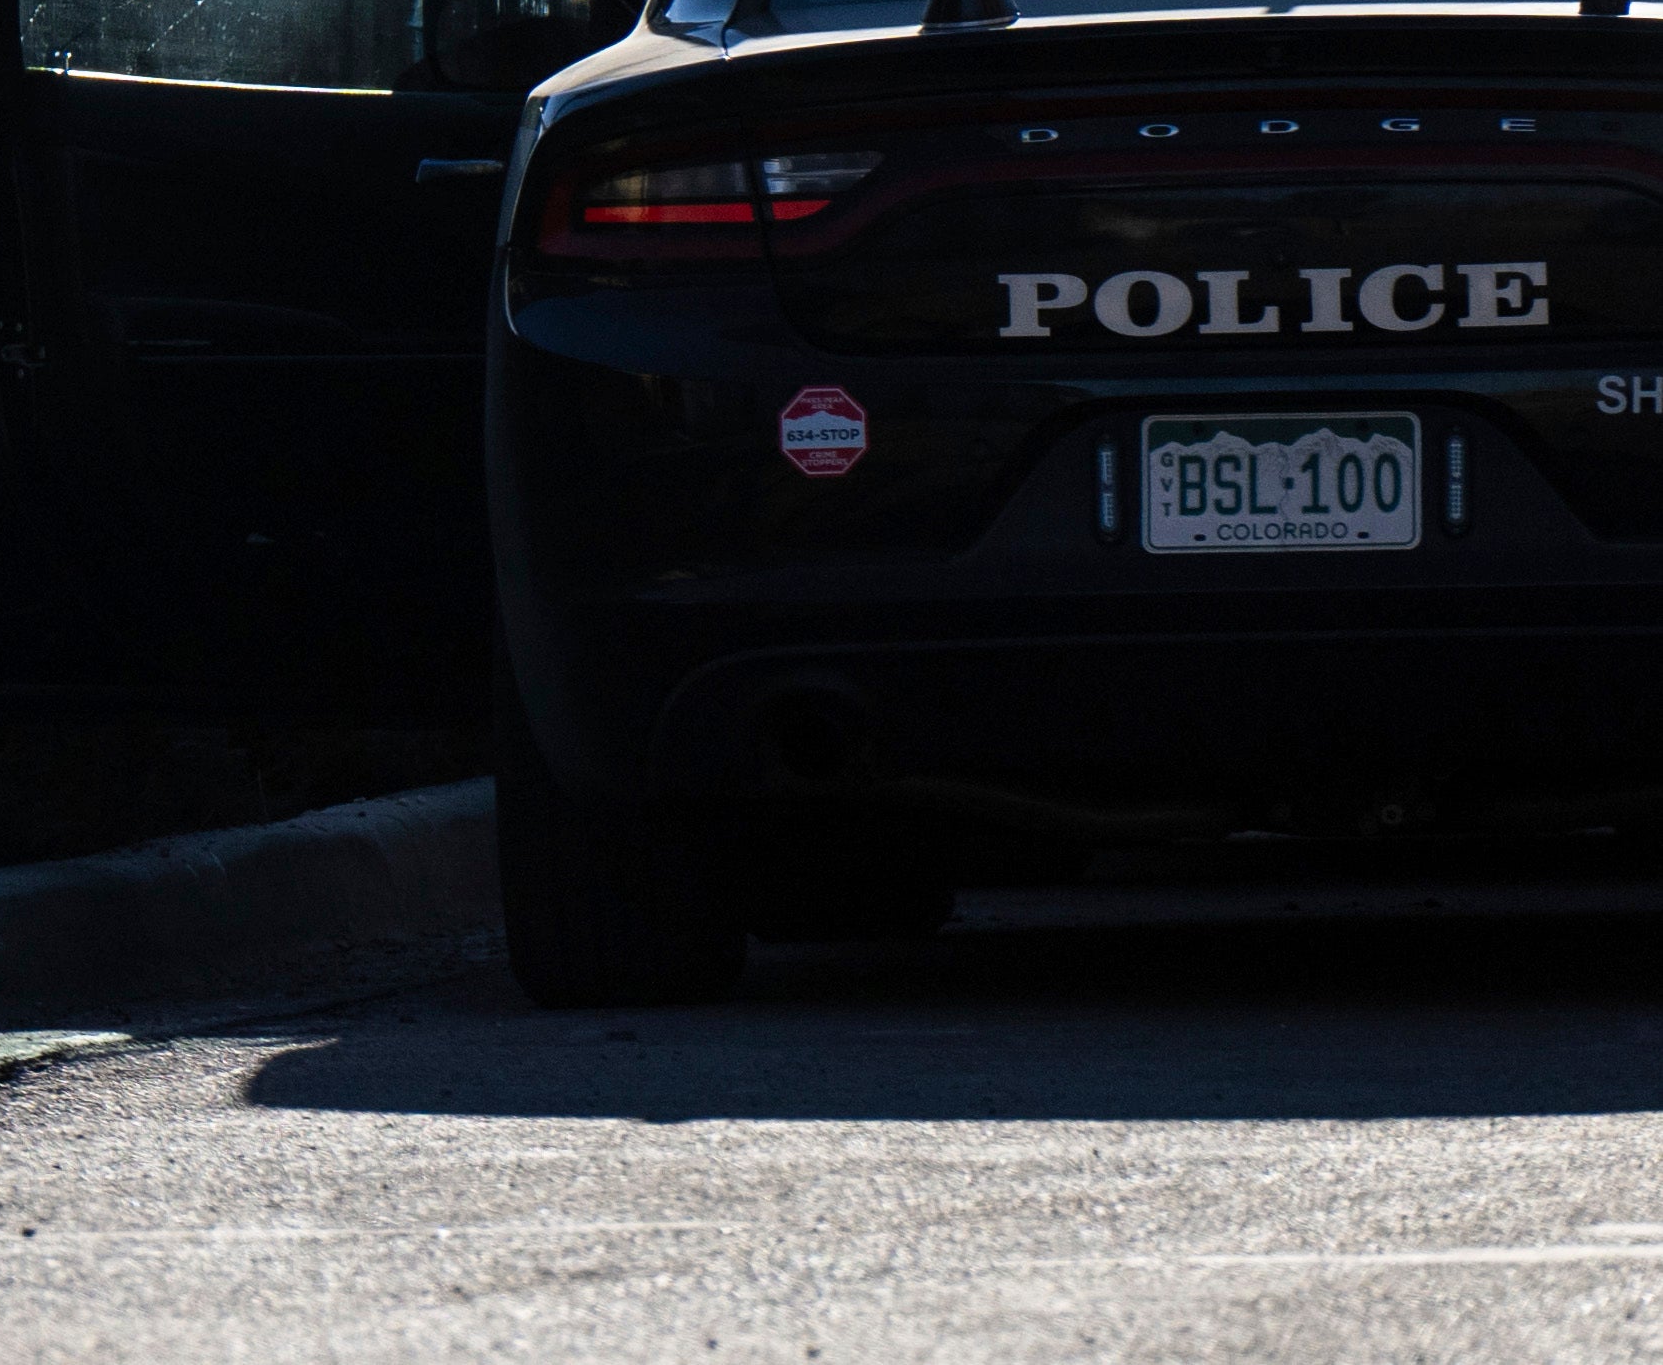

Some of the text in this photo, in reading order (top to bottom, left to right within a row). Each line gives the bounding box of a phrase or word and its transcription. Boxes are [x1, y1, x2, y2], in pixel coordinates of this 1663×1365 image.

[1020, 118, 1537, 143] DODGE
[998, 262, 1550, 339] POLICE
[787, 428, 861, 442] 634-STOP
[1216, 522, 1349, 542] COLORADO
